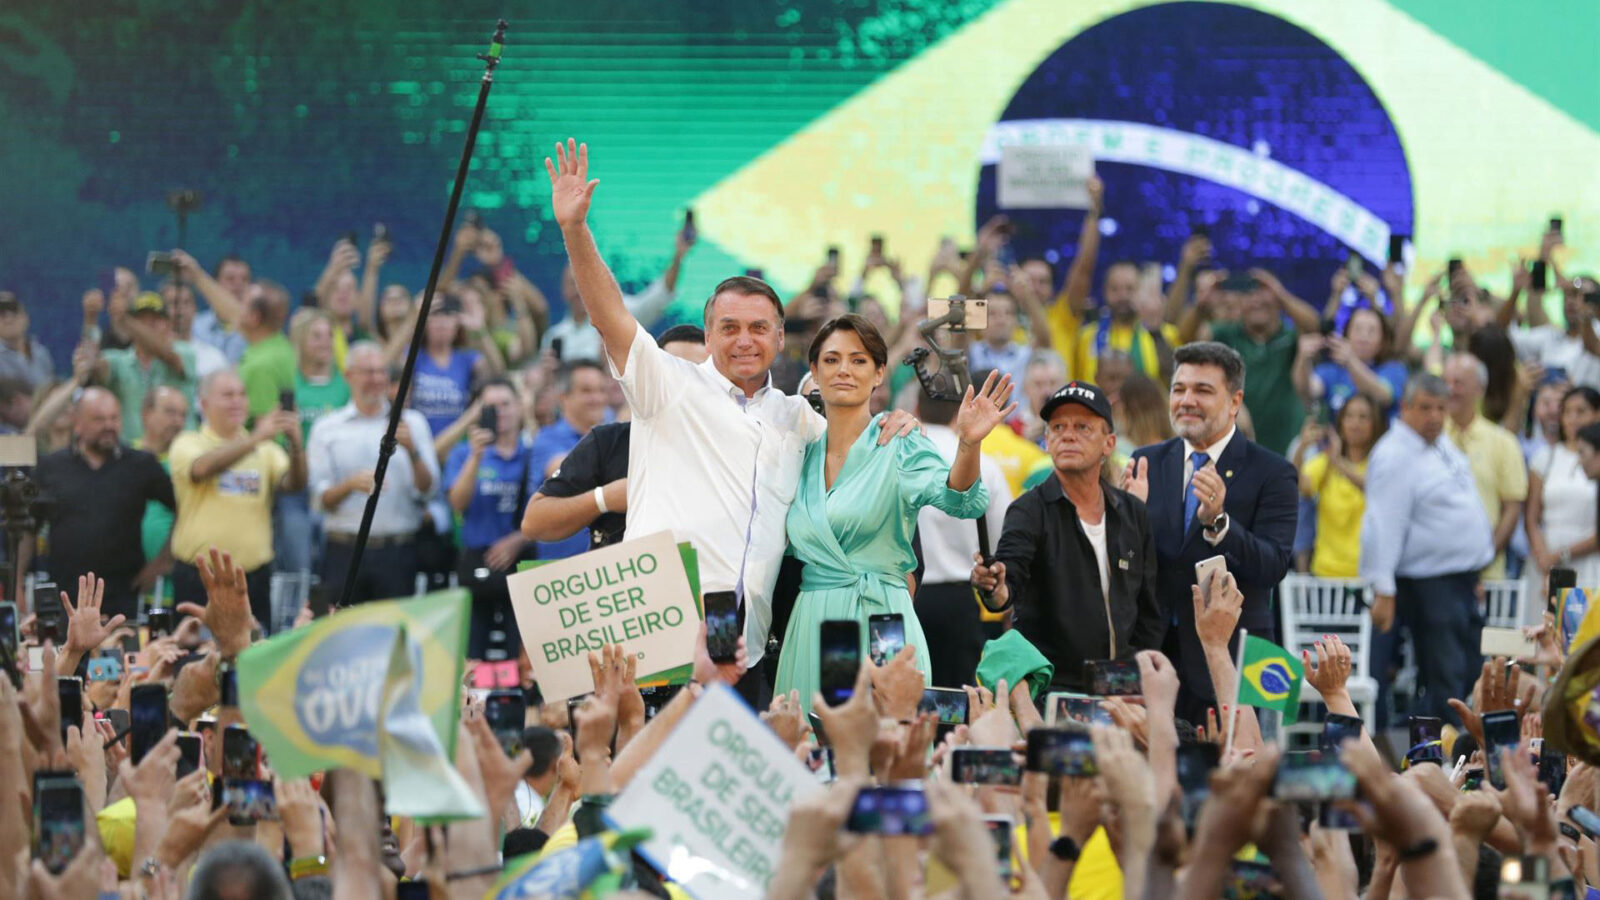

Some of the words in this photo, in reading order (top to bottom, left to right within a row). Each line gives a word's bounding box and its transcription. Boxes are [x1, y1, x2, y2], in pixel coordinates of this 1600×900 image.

[533, 553, 657, 605] ORGULHO
[559, 602, 593, 629] DE
[596, 586, 647, 618] SER
[542, 606, 684, 663] BRASILEIRO
[701, 761, 743, 806] DE
